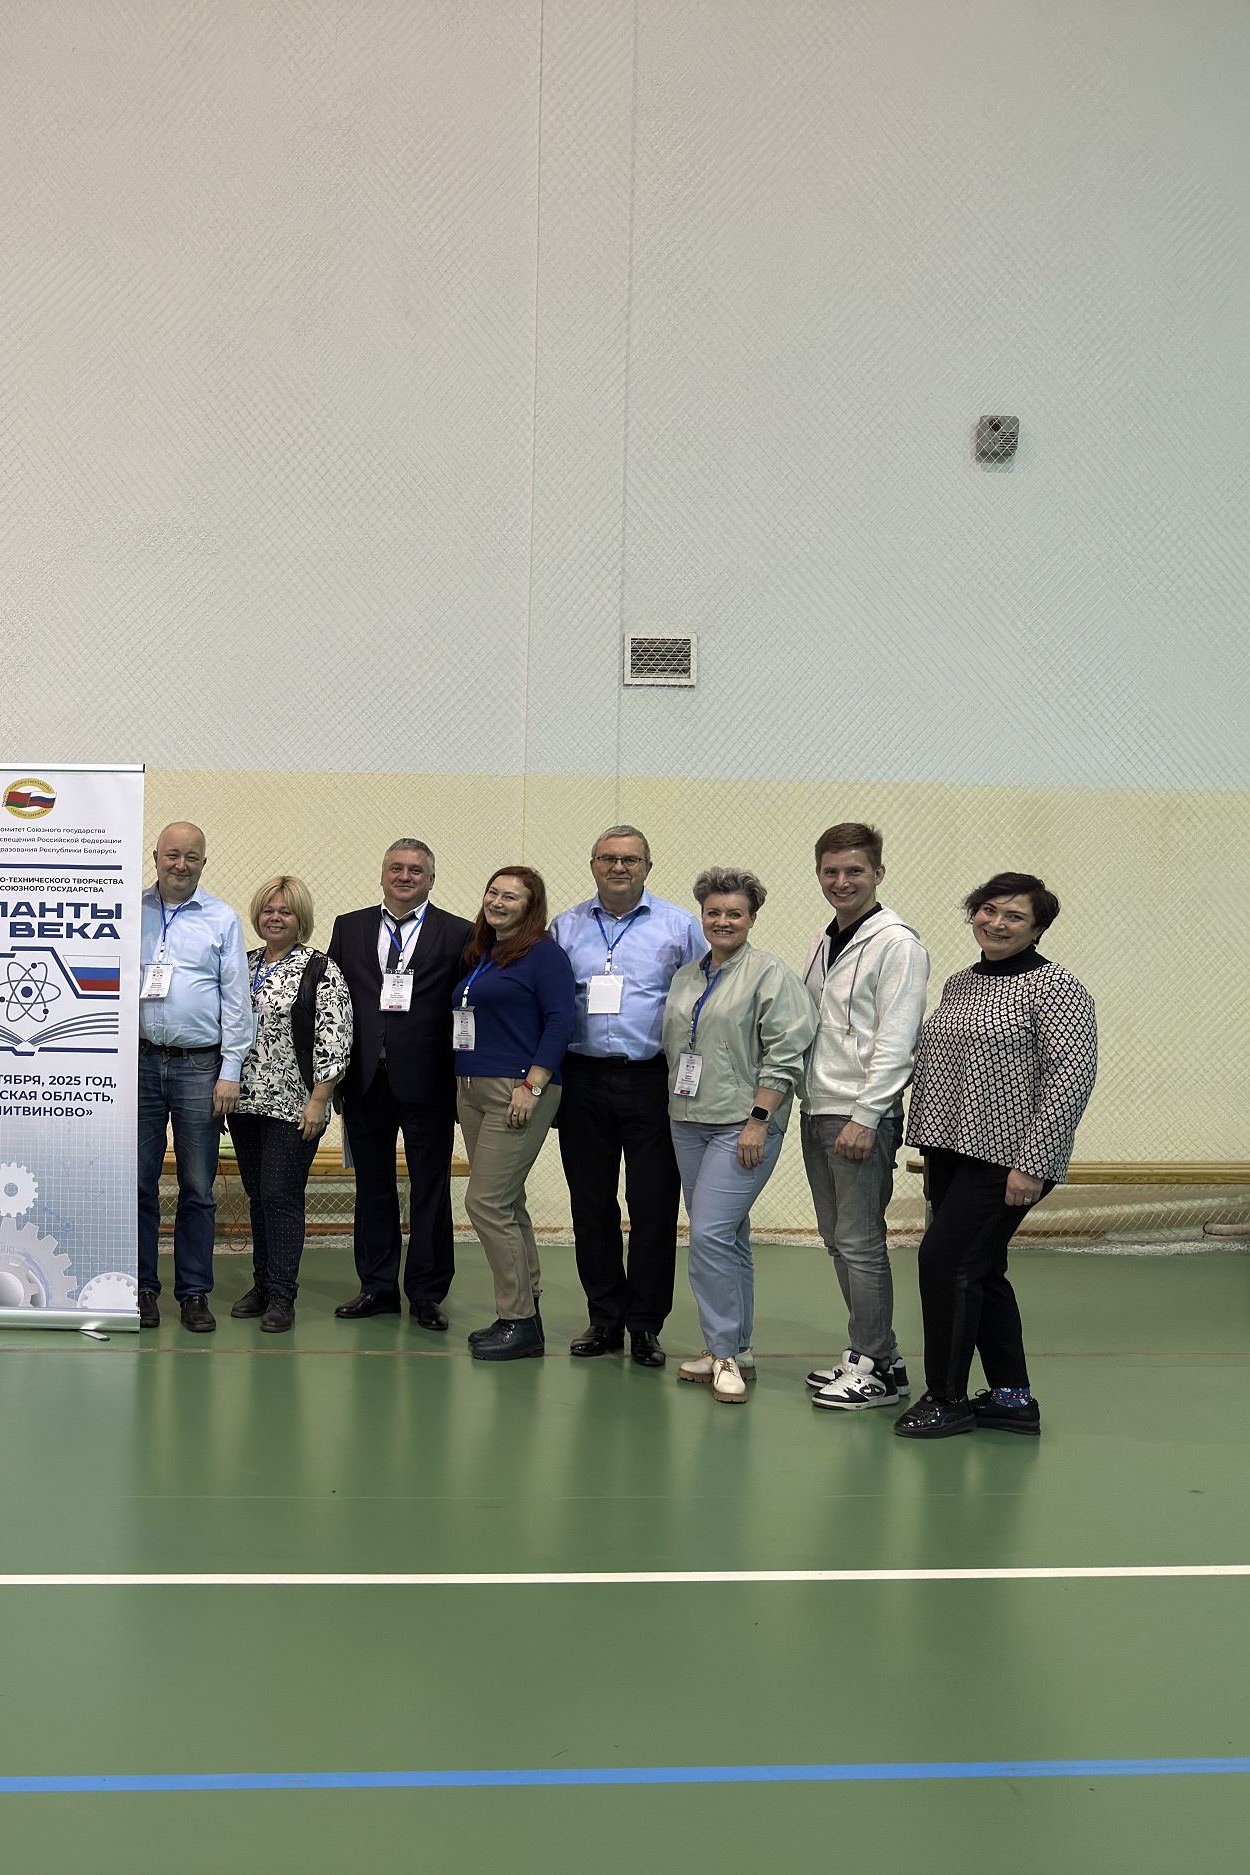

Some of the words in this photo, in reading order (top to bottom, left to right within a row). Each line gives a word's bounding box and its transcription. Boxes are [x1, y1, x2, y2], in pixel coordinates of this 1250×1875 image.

[39, 846, 81, 854] Республики
[9, 921, 121, 939] ВЕКА
[48, 1075, 81, 1086] 2025
[85, 1076, 117, 1088] ГОД,
[41, 1091, 114, 1104] ОБЛАСТЬ,
